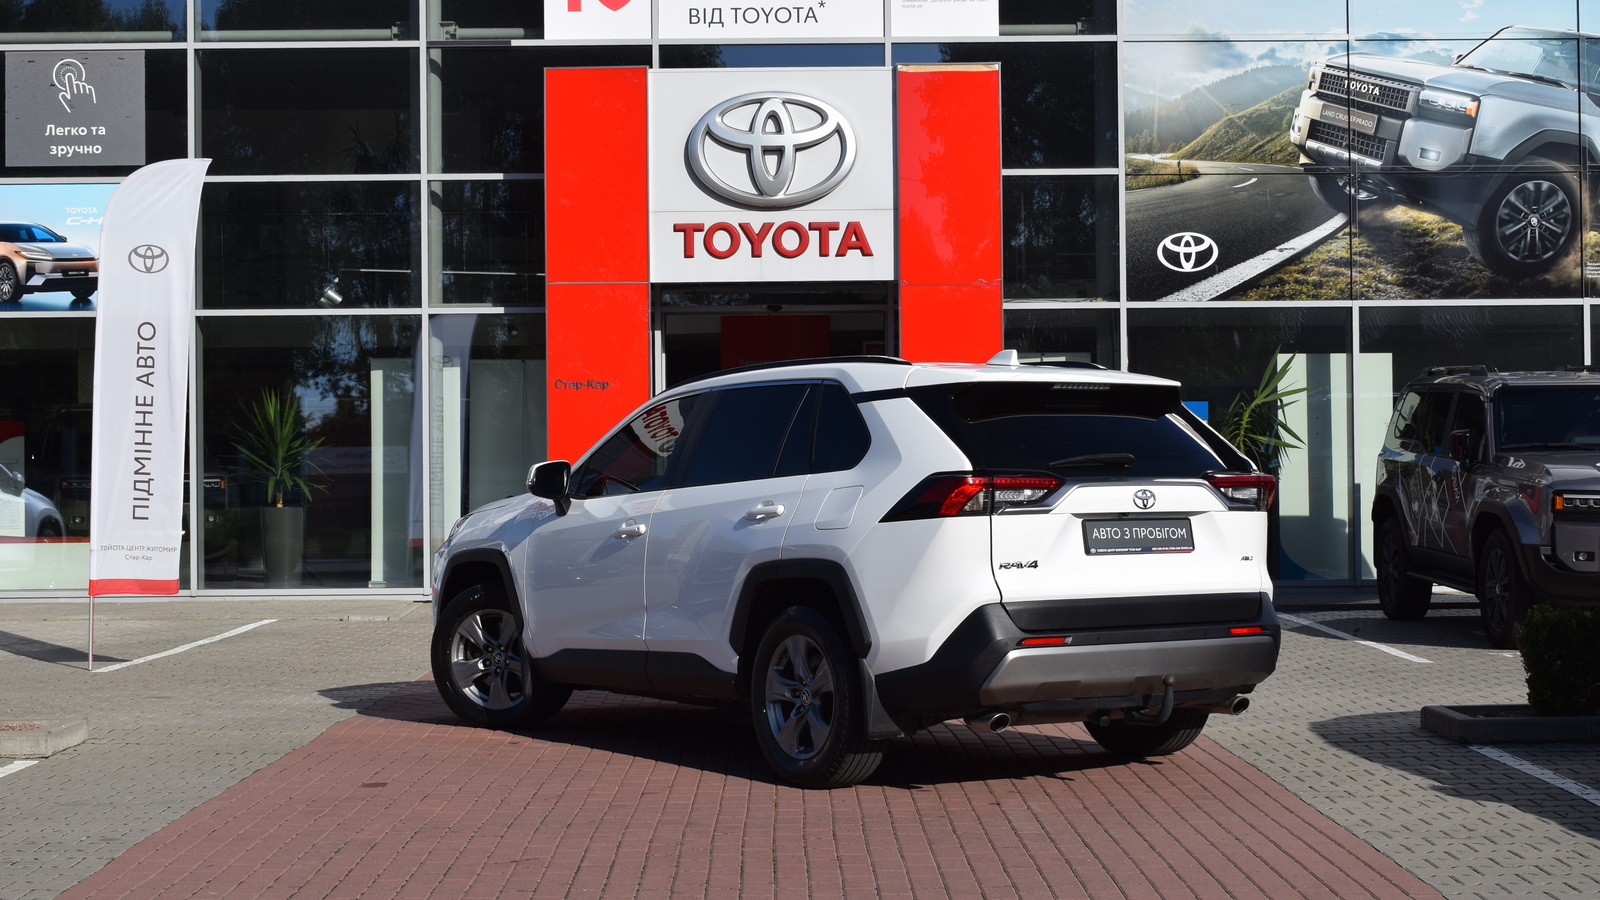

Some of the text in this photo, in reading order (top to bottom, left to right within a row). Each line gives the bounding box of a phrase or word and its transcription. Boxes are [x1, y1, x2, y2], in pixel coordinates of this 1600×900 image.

[688, 7, 725, 28] ВІД
[1344, 80, 1379, 95] TOYOTA
[1322, 109, 1335, 118] LAND
[1356, 117, 1373, 127] PRADO
[44, 124, 106, 136] Легко та
[49, 144, 102, 157] зручно
[65, 216, 104, 225] C-H
[672, 221, 874, 260] TOYOTA
[555, 379, 610, 391] Стар-Кар
[132, 321, 157, 521] ПІДМІННЕ АВТО
[1092, 527, 1121, 539] АВТО
[1133, 527, 1187, 539] ПРОБІГОМ
[998, 560, 1039, 570] RAV4
